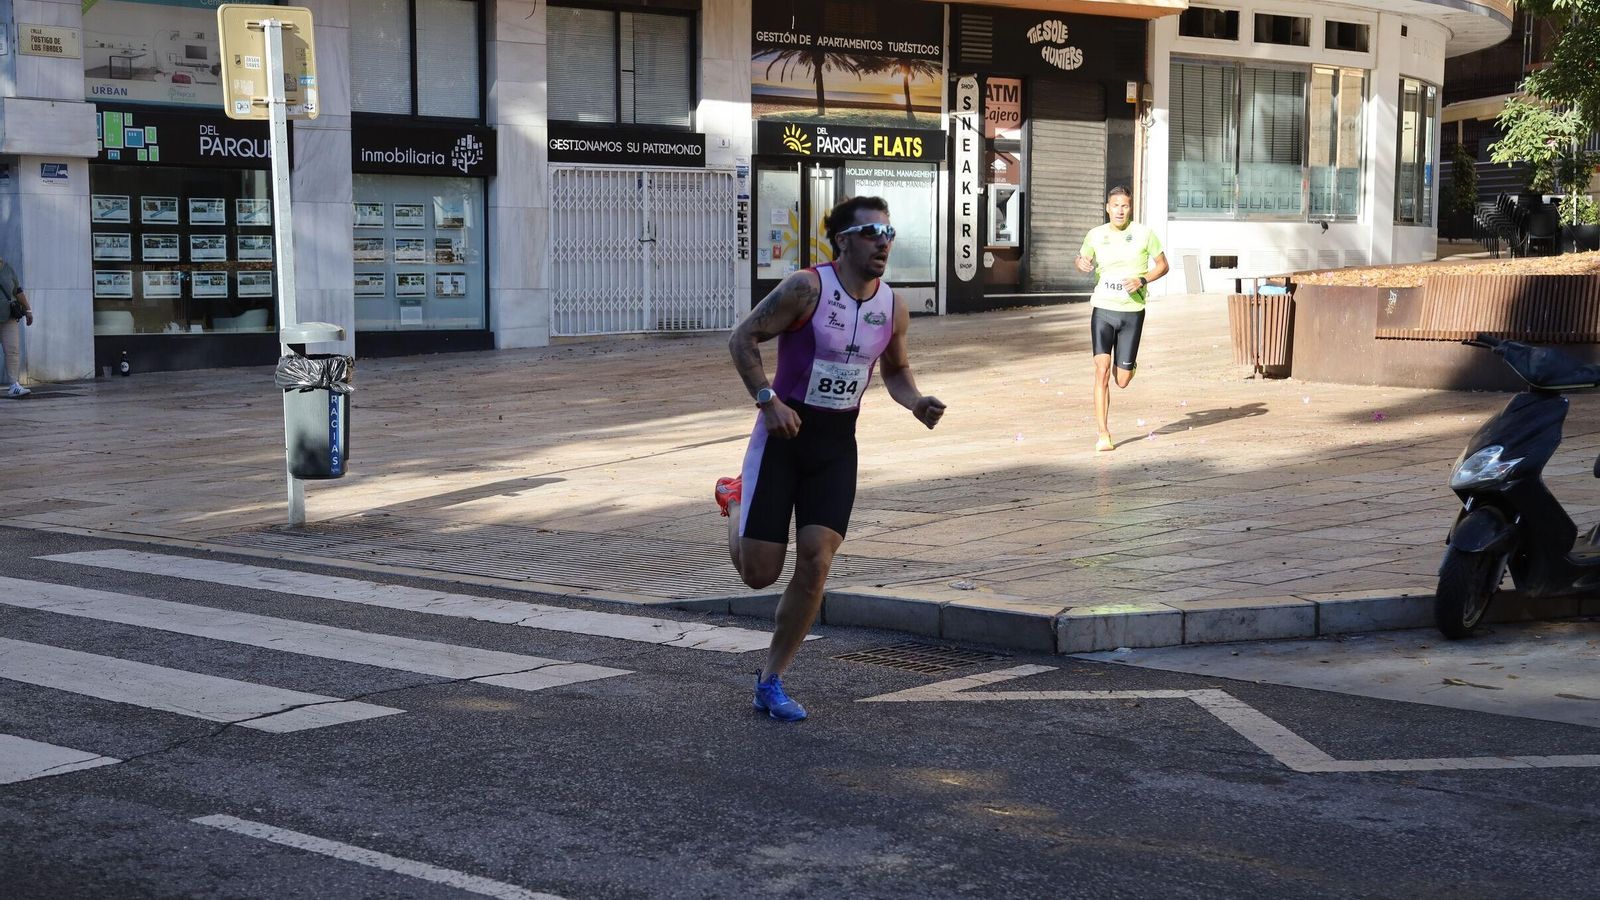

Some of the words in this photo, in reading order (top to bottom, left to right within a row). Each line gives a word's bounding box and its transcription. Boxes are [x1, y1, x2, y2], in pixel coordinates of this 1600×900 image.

[31, 35, 53, 44] POSTIGO
[54, 37, 61, 45] DE
[1027, 23, 1044, 44] THE
[1042, 19, 1069, 44] SOLE
[31, 44, 42, 52] LOS
[756, 31, 798, 44] GESTIÓN
[799, 34, 811, 45] DE
[816, 36, 883, 51] APARTAMENTOS
[888, 41, 940, 55] TURÍSTICOS
[1041, 46, 1083, 70] HUNTERS
[91, 86, 128, 96] URBAN
[985, 84, 1019, 103] ATM
[200, 124, 220, 136] DEL
[817, 127, 828, 135] DEL
[549, 138, 623, 153] GESTIONAMOS
[627, 142, 640, 153] SU
[643, 142, 702, 156] PATRIMONIO
[817, 136, 867, 155] PARQUE
[873, 135, 923, 158] FLATS
[361, 147, 445, 165] inmobiliaria
[845, 167, 873, 177] HOLIDAY
[874, 168, 895, 177] RENTAL
[896, 169, 937, 178] MANAGEMENT
[962, 95, 972, 259] SNEAKERS
[1104, 282, 1123, 291] 148
[817, 377, 858, 395] 834
[330, 395, 339, 465] RACIAS
